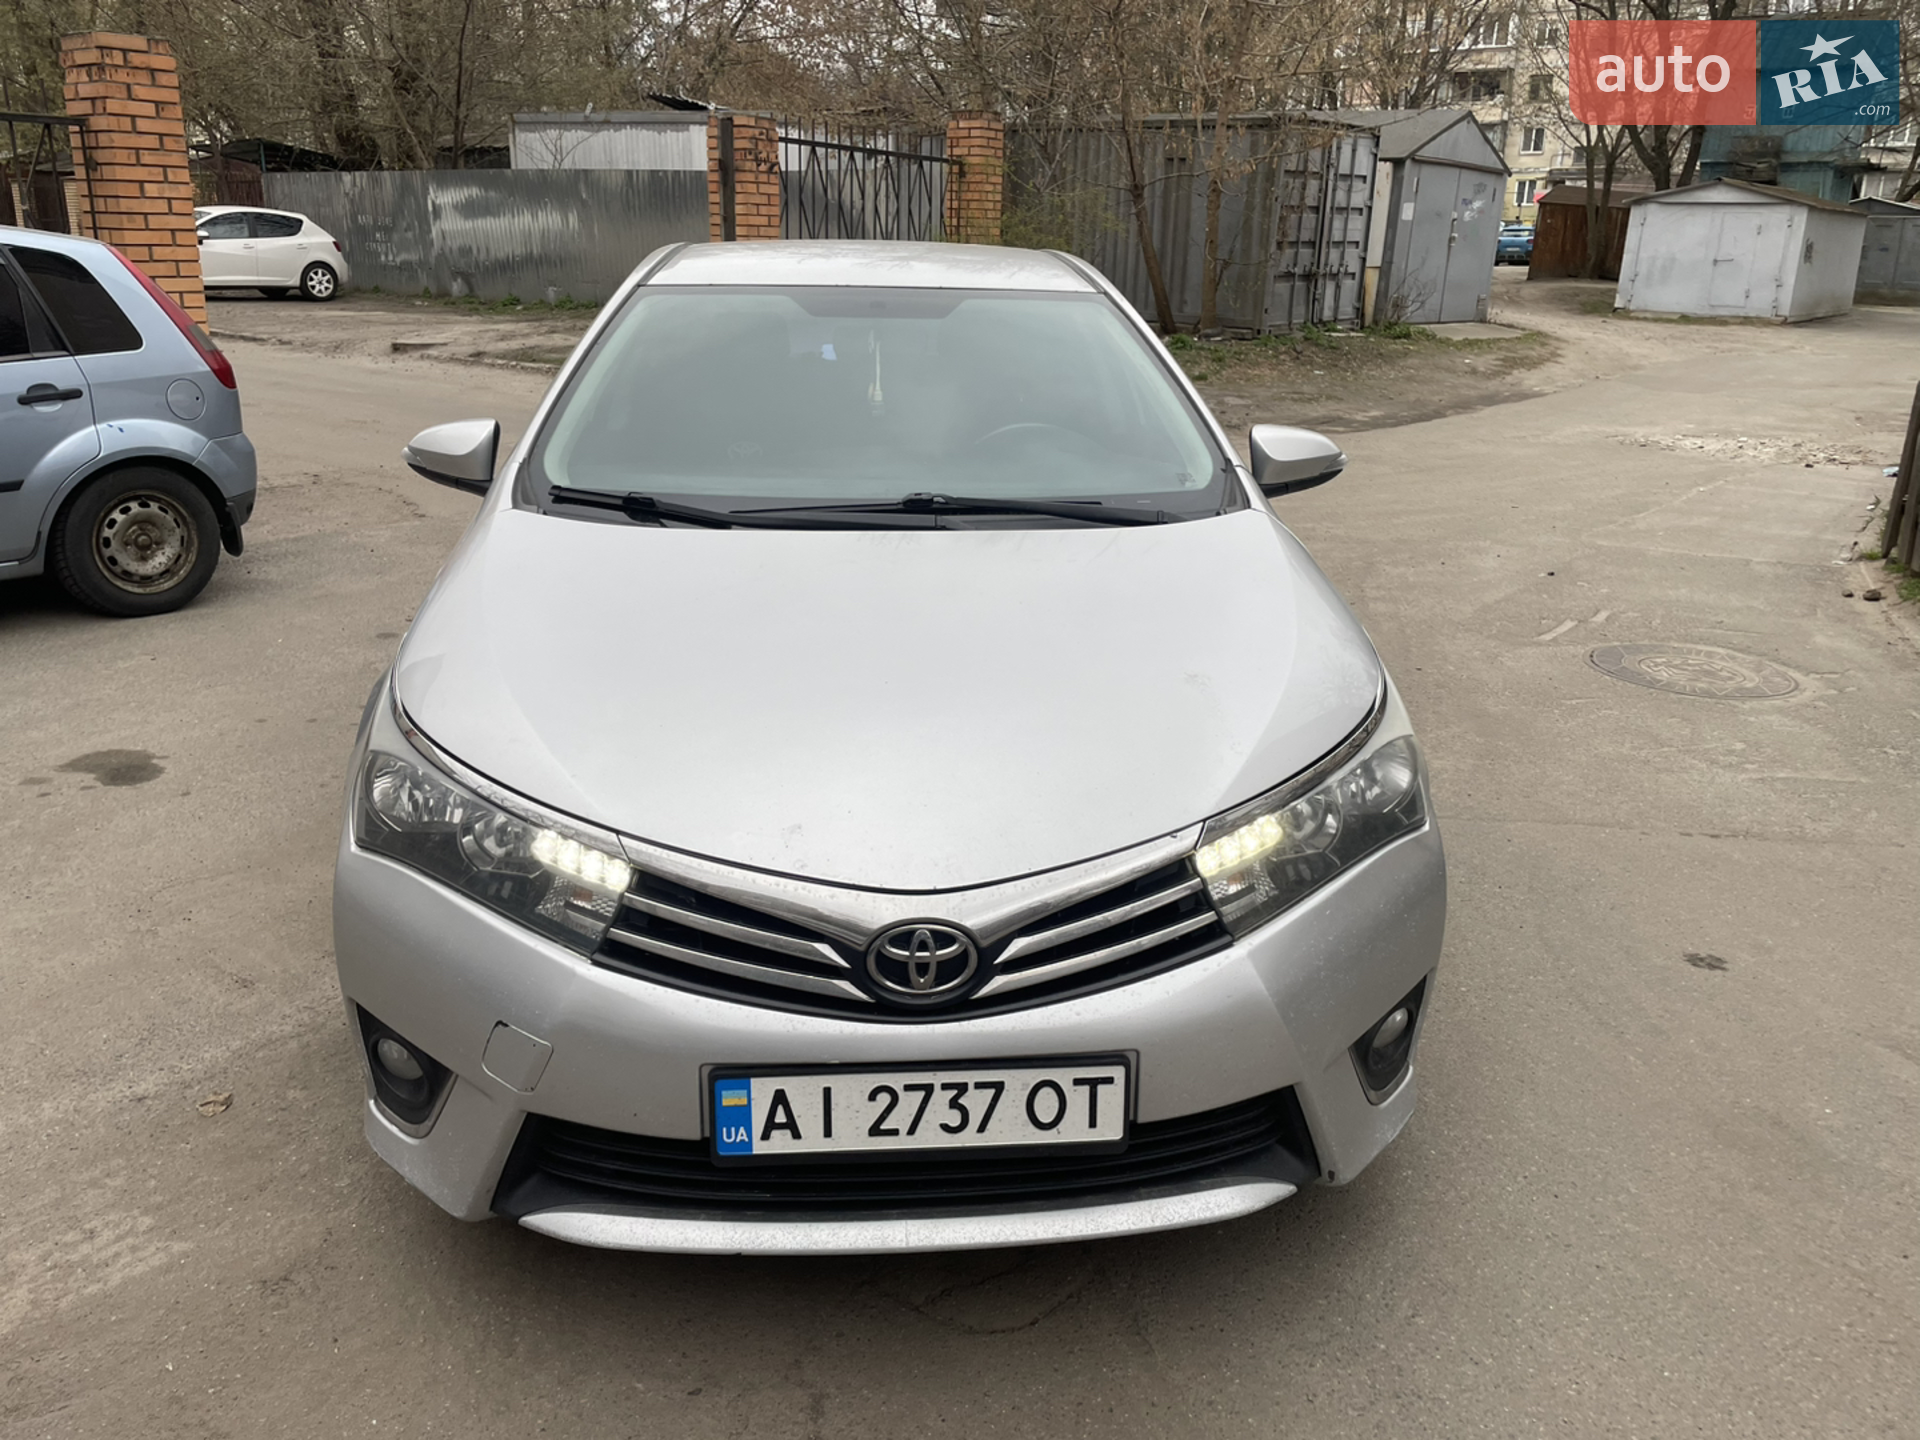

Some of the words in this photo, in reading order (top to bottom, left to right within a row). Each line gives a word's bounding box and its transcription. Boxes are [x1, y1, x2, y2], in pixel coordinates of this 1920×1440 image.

[760, 1086, 832, 1141] AI
[867, 1081, 1005, 1137] 2737
[1025, 1076, 1115, 1131] OT
[722, 1126, 749, 1143] UA
